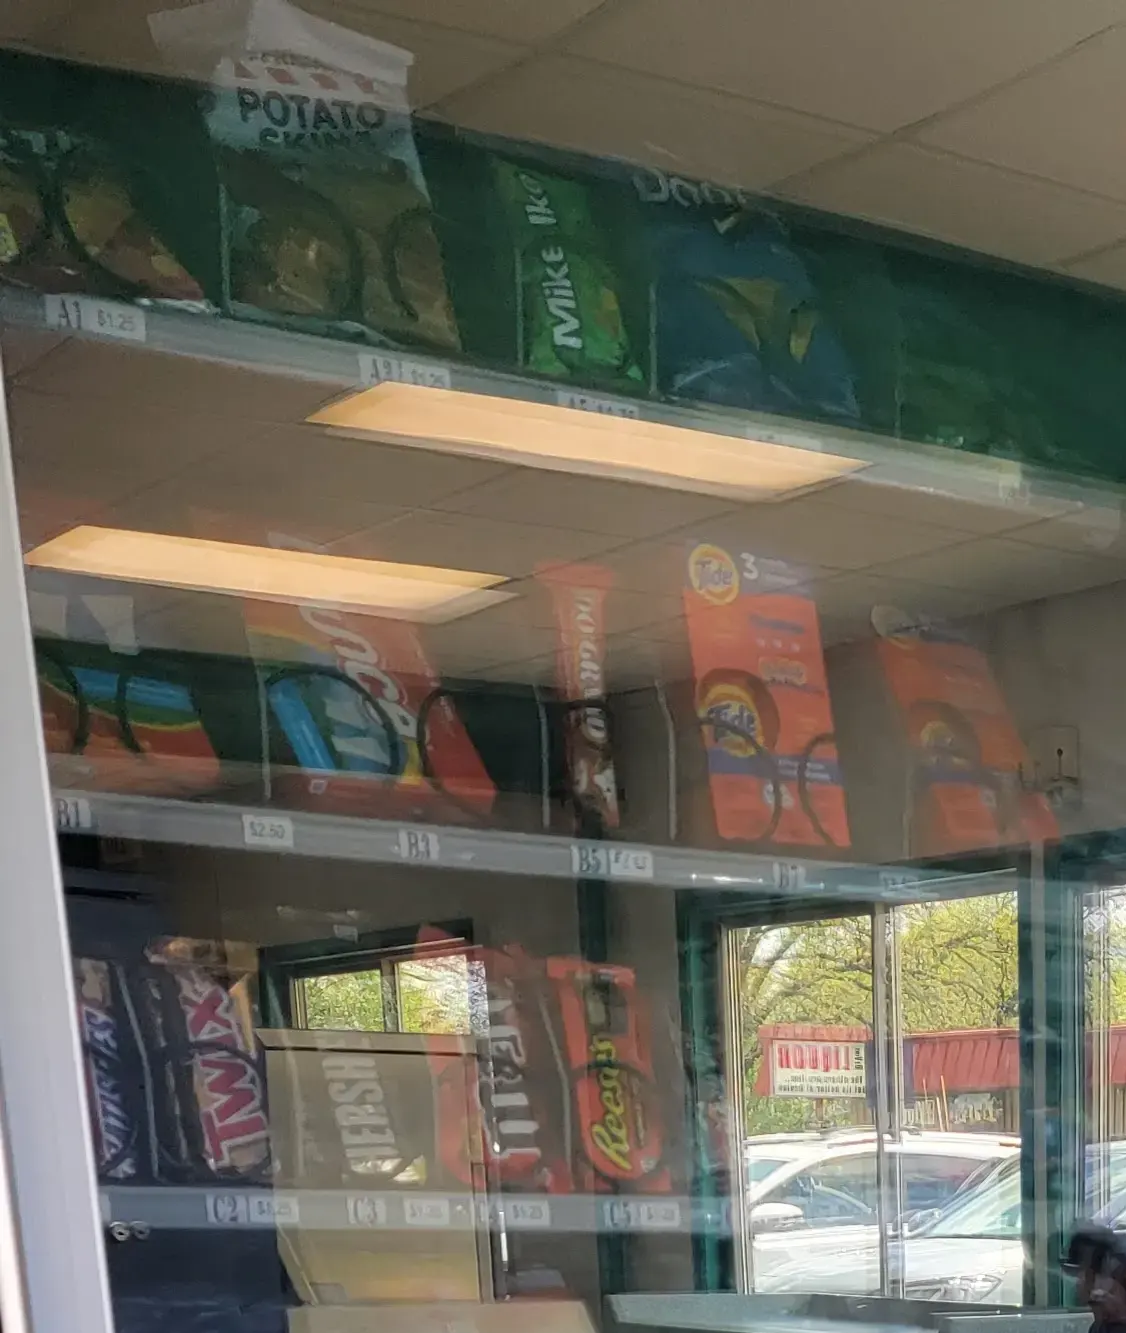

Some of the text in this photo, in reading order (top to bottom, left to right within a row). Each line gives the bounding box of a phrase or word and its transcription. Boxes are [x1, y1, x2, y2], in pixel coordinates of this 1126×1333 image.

[237, 86, 388, 130] POTATO
[740, 552, 759, 581] 3
[180, 985, 269, 1169] TWIX
